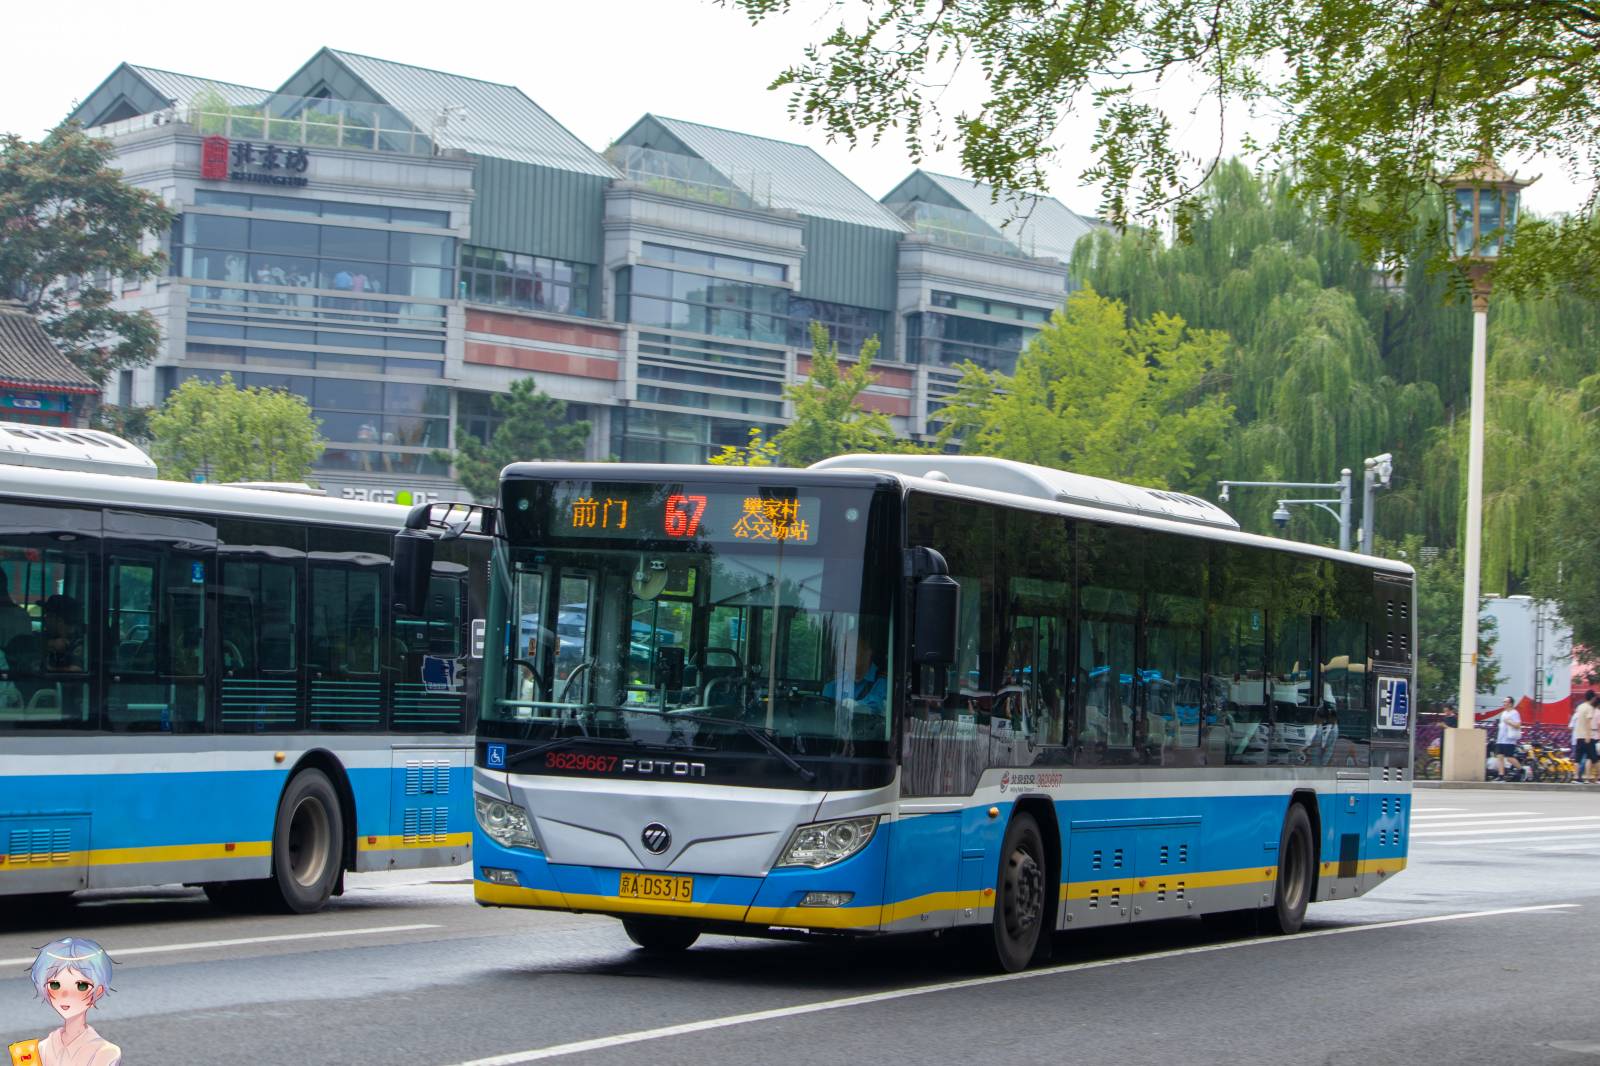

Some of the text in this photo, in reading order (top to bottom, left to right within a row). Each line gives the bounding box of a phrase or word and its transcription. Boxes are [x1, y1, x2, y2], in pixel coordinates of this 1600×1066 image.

[572, 498, 628, 529] 前门
[664, 495, 707, 538] 67
[742, 497, 801, 520] 樊家村
[732, 518, 810, 541] 公交场站
[545, 752, 618, 773] 3629667
[621, 758, 706, 778] FOTON
